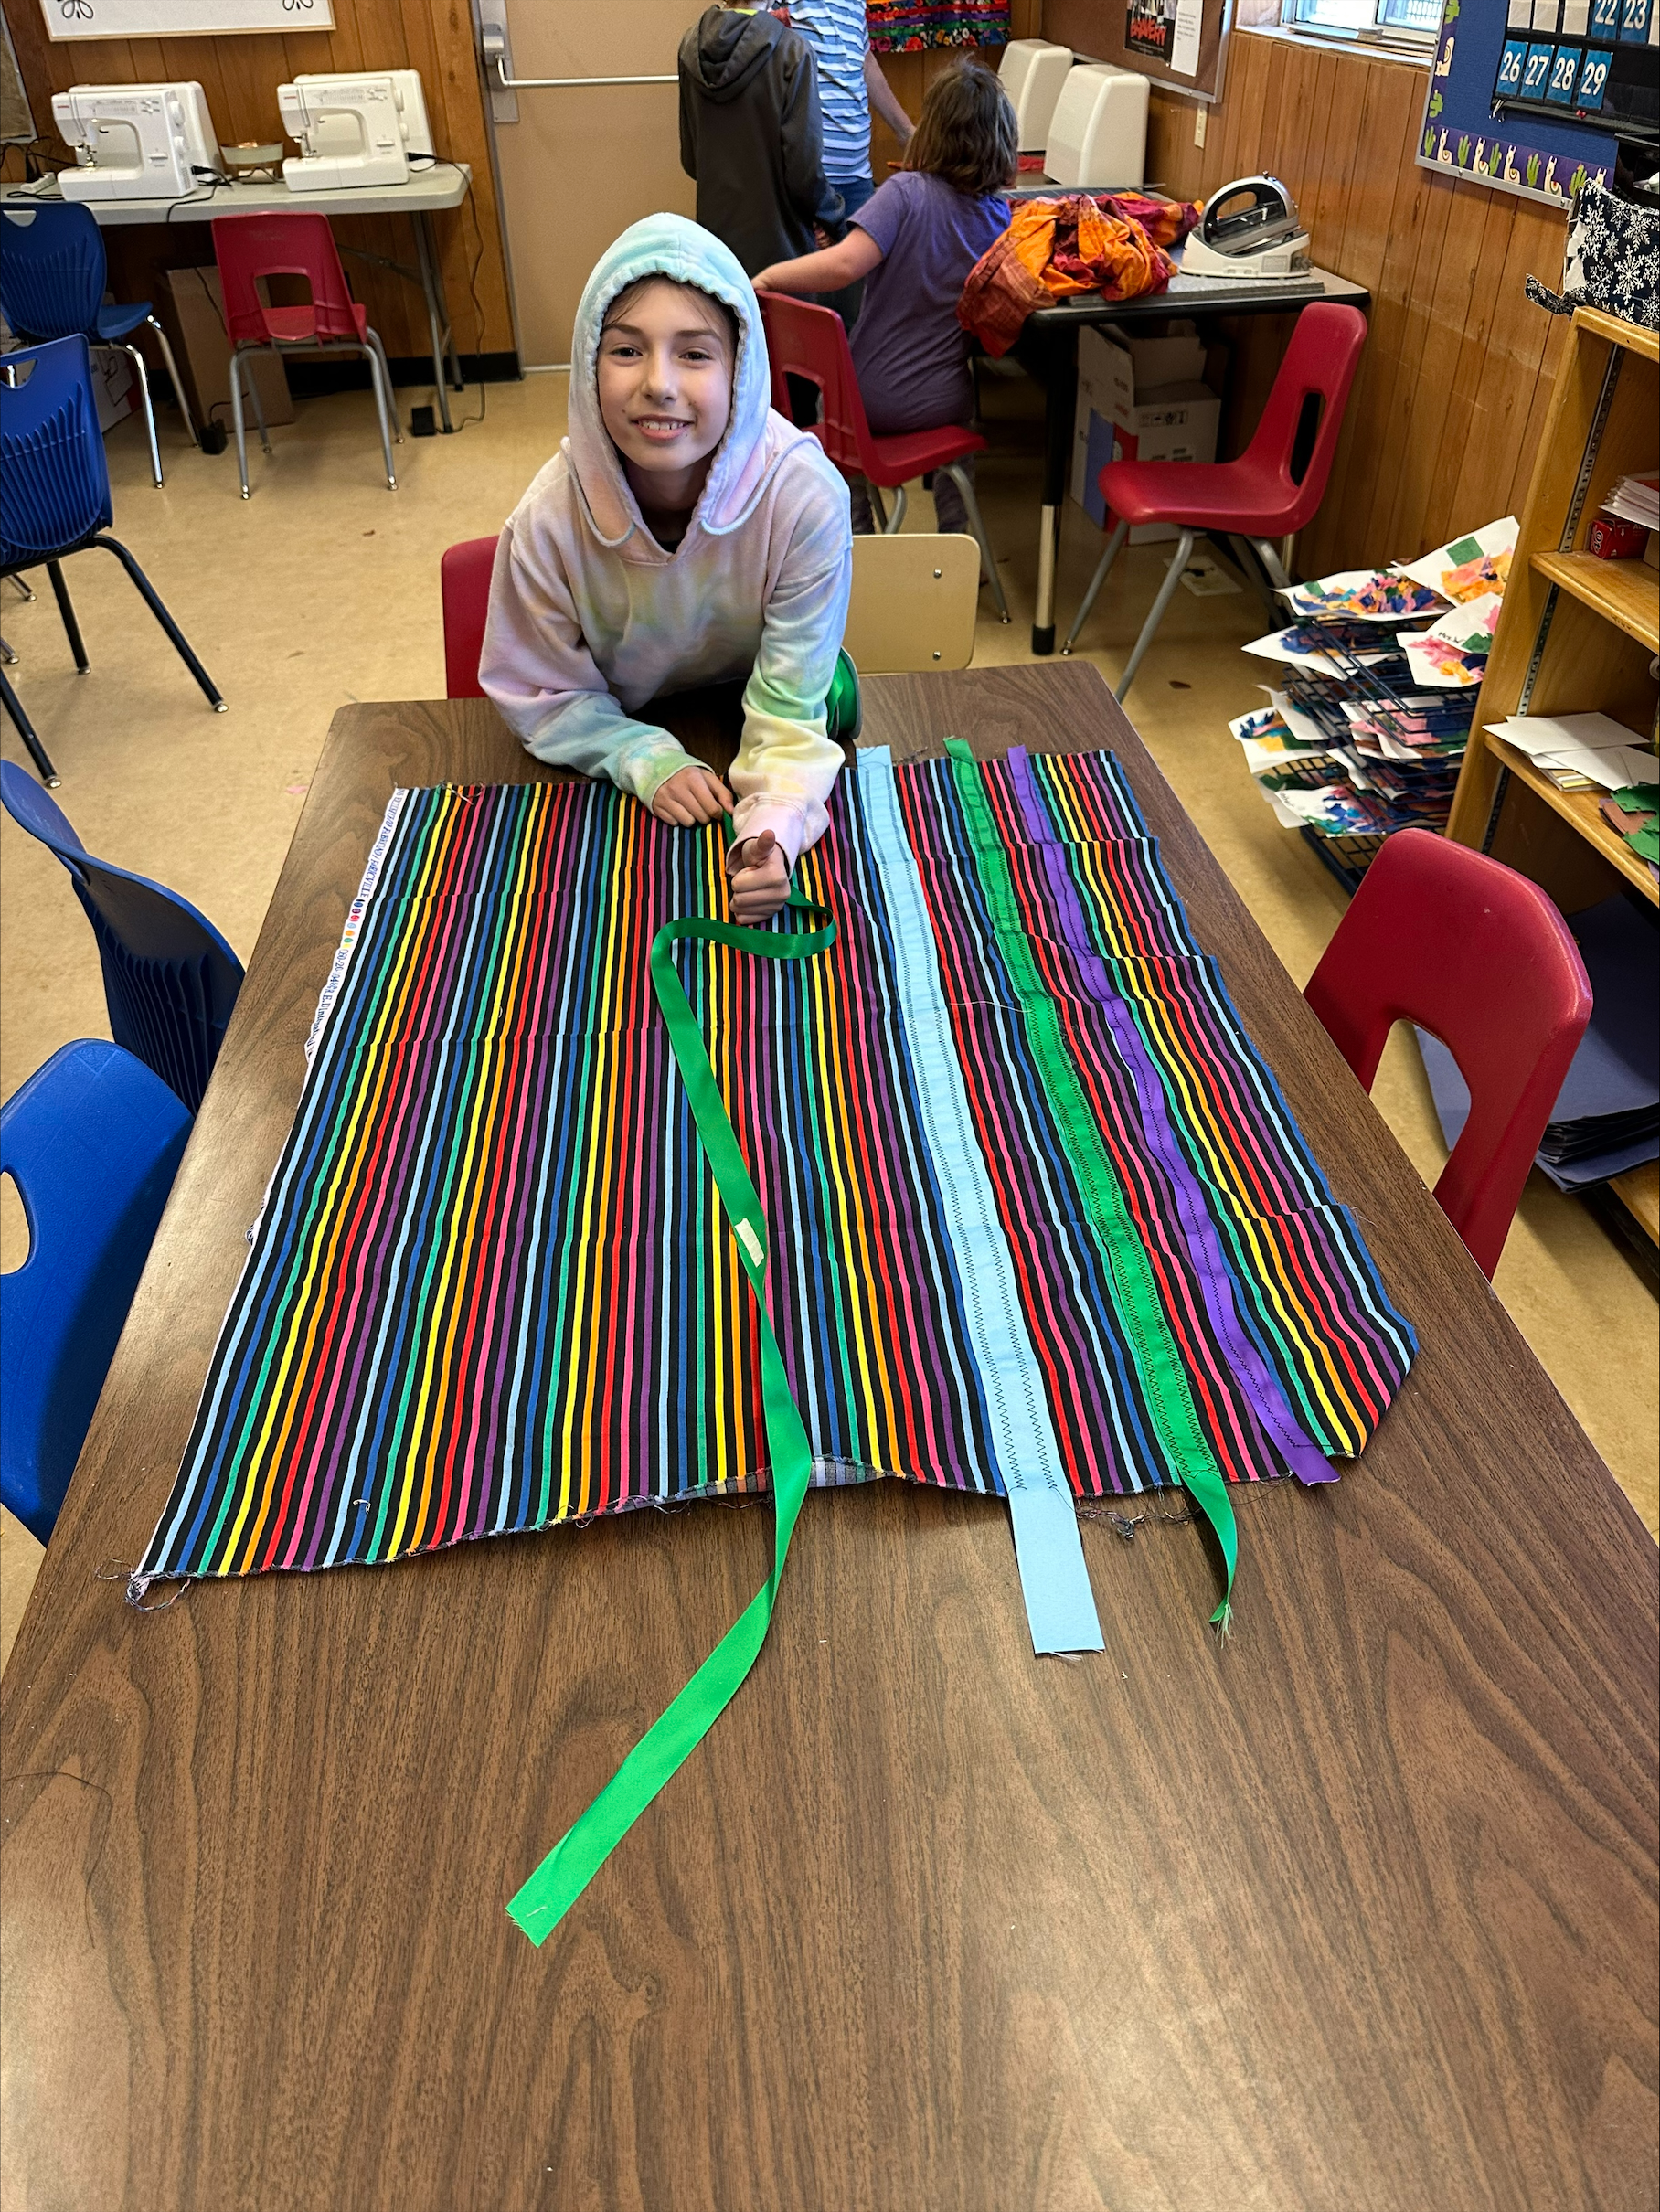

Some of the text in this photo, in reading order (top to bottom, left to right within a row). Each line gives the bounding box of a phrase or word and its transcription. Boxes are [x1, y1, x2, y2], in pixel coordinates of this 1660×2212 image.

[1595, 0, 1647, 29] 22 23
[1500, 51, 1606, 96] 26 27 28 29
